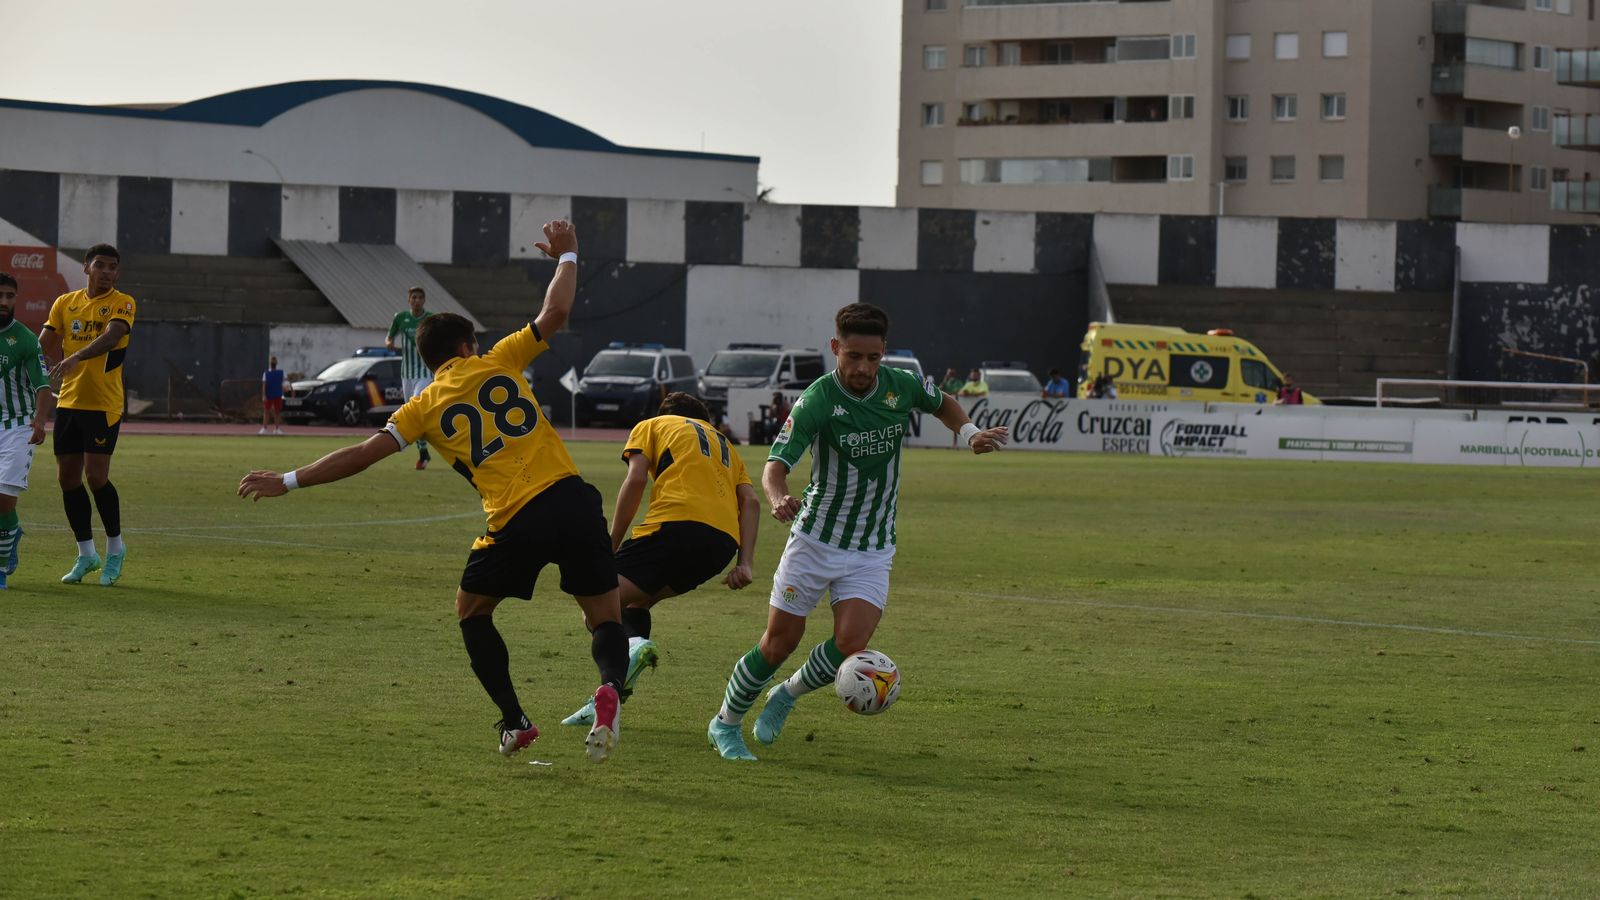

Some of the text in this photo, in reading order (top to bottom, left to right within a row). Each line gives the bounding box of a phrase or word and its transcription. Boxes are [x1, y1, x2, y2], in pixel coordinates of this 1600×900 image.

[1104, 357, 1165, 381] DYA
[440, 375, 538, 467] 28
[968, 398, 1069, 444] Coca-Cola
[1176, 423, 1248, 437] FOOTBALL
[685, 418, 731, 470] 11
[839, 423, 903, 447] FOREVER
[1173, 436, 1227, 448] IMPACT
[851, 440, 894, 458] GREEN
[1460, 444, 1520, 455] MARBELLA
